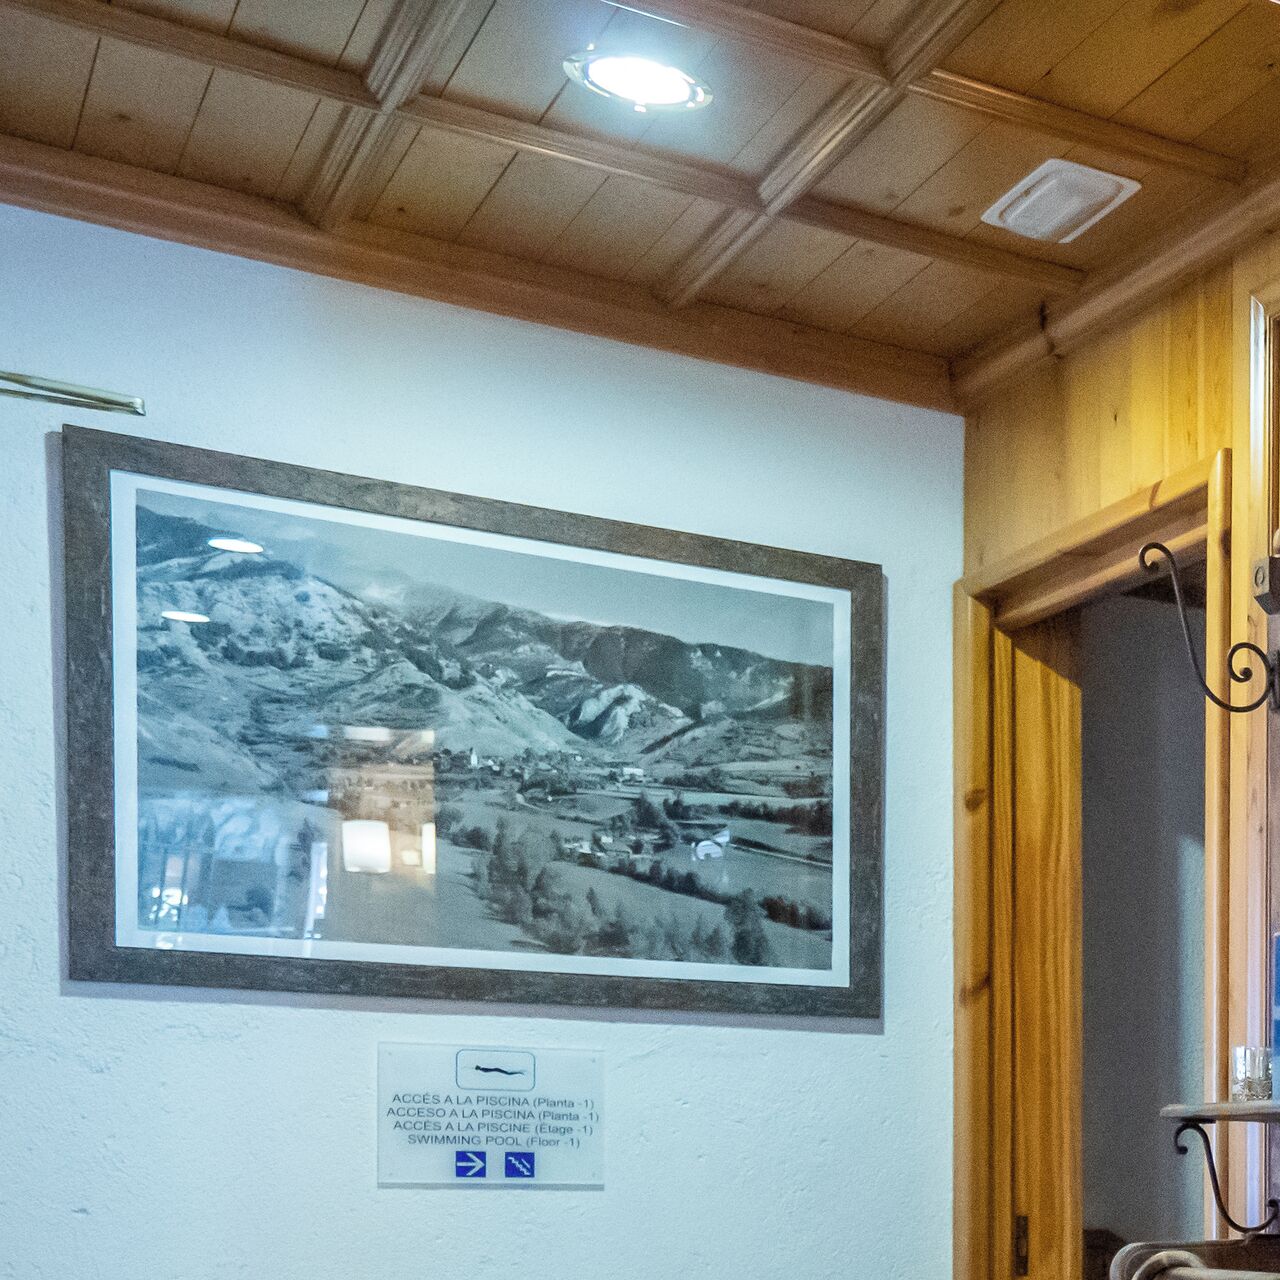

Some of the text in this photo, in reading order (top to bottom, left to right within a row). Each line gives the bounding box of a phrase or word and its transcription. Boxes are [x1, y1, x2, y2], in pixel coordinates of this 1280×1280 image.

[444, 1095, 453, 1105] A
[456, 1096, 473, 1106] LA
[476, 1096, 530, 1107] PISCINA
[533, 1098, 575, 1109] (Planta
[386, 1107, 446, 1118] ACCESO
[449, 1108, 459, 1119] A
[462, 1109, 479, 1119] LA
[481, 1109, 535, 1120] PISCINA
[538, 1111, 580, 1122] (Planta
[445, 1122, 454, 1132] A
[457, 1122, 474, 1132] LA
[477, 1122, 531, 1133] PISCINE
[408, 1134, 481, 1145] SWIMMING
[485, 1136, 521, 1146] POOL
[526, 1136, 560, 1149] (Floor
